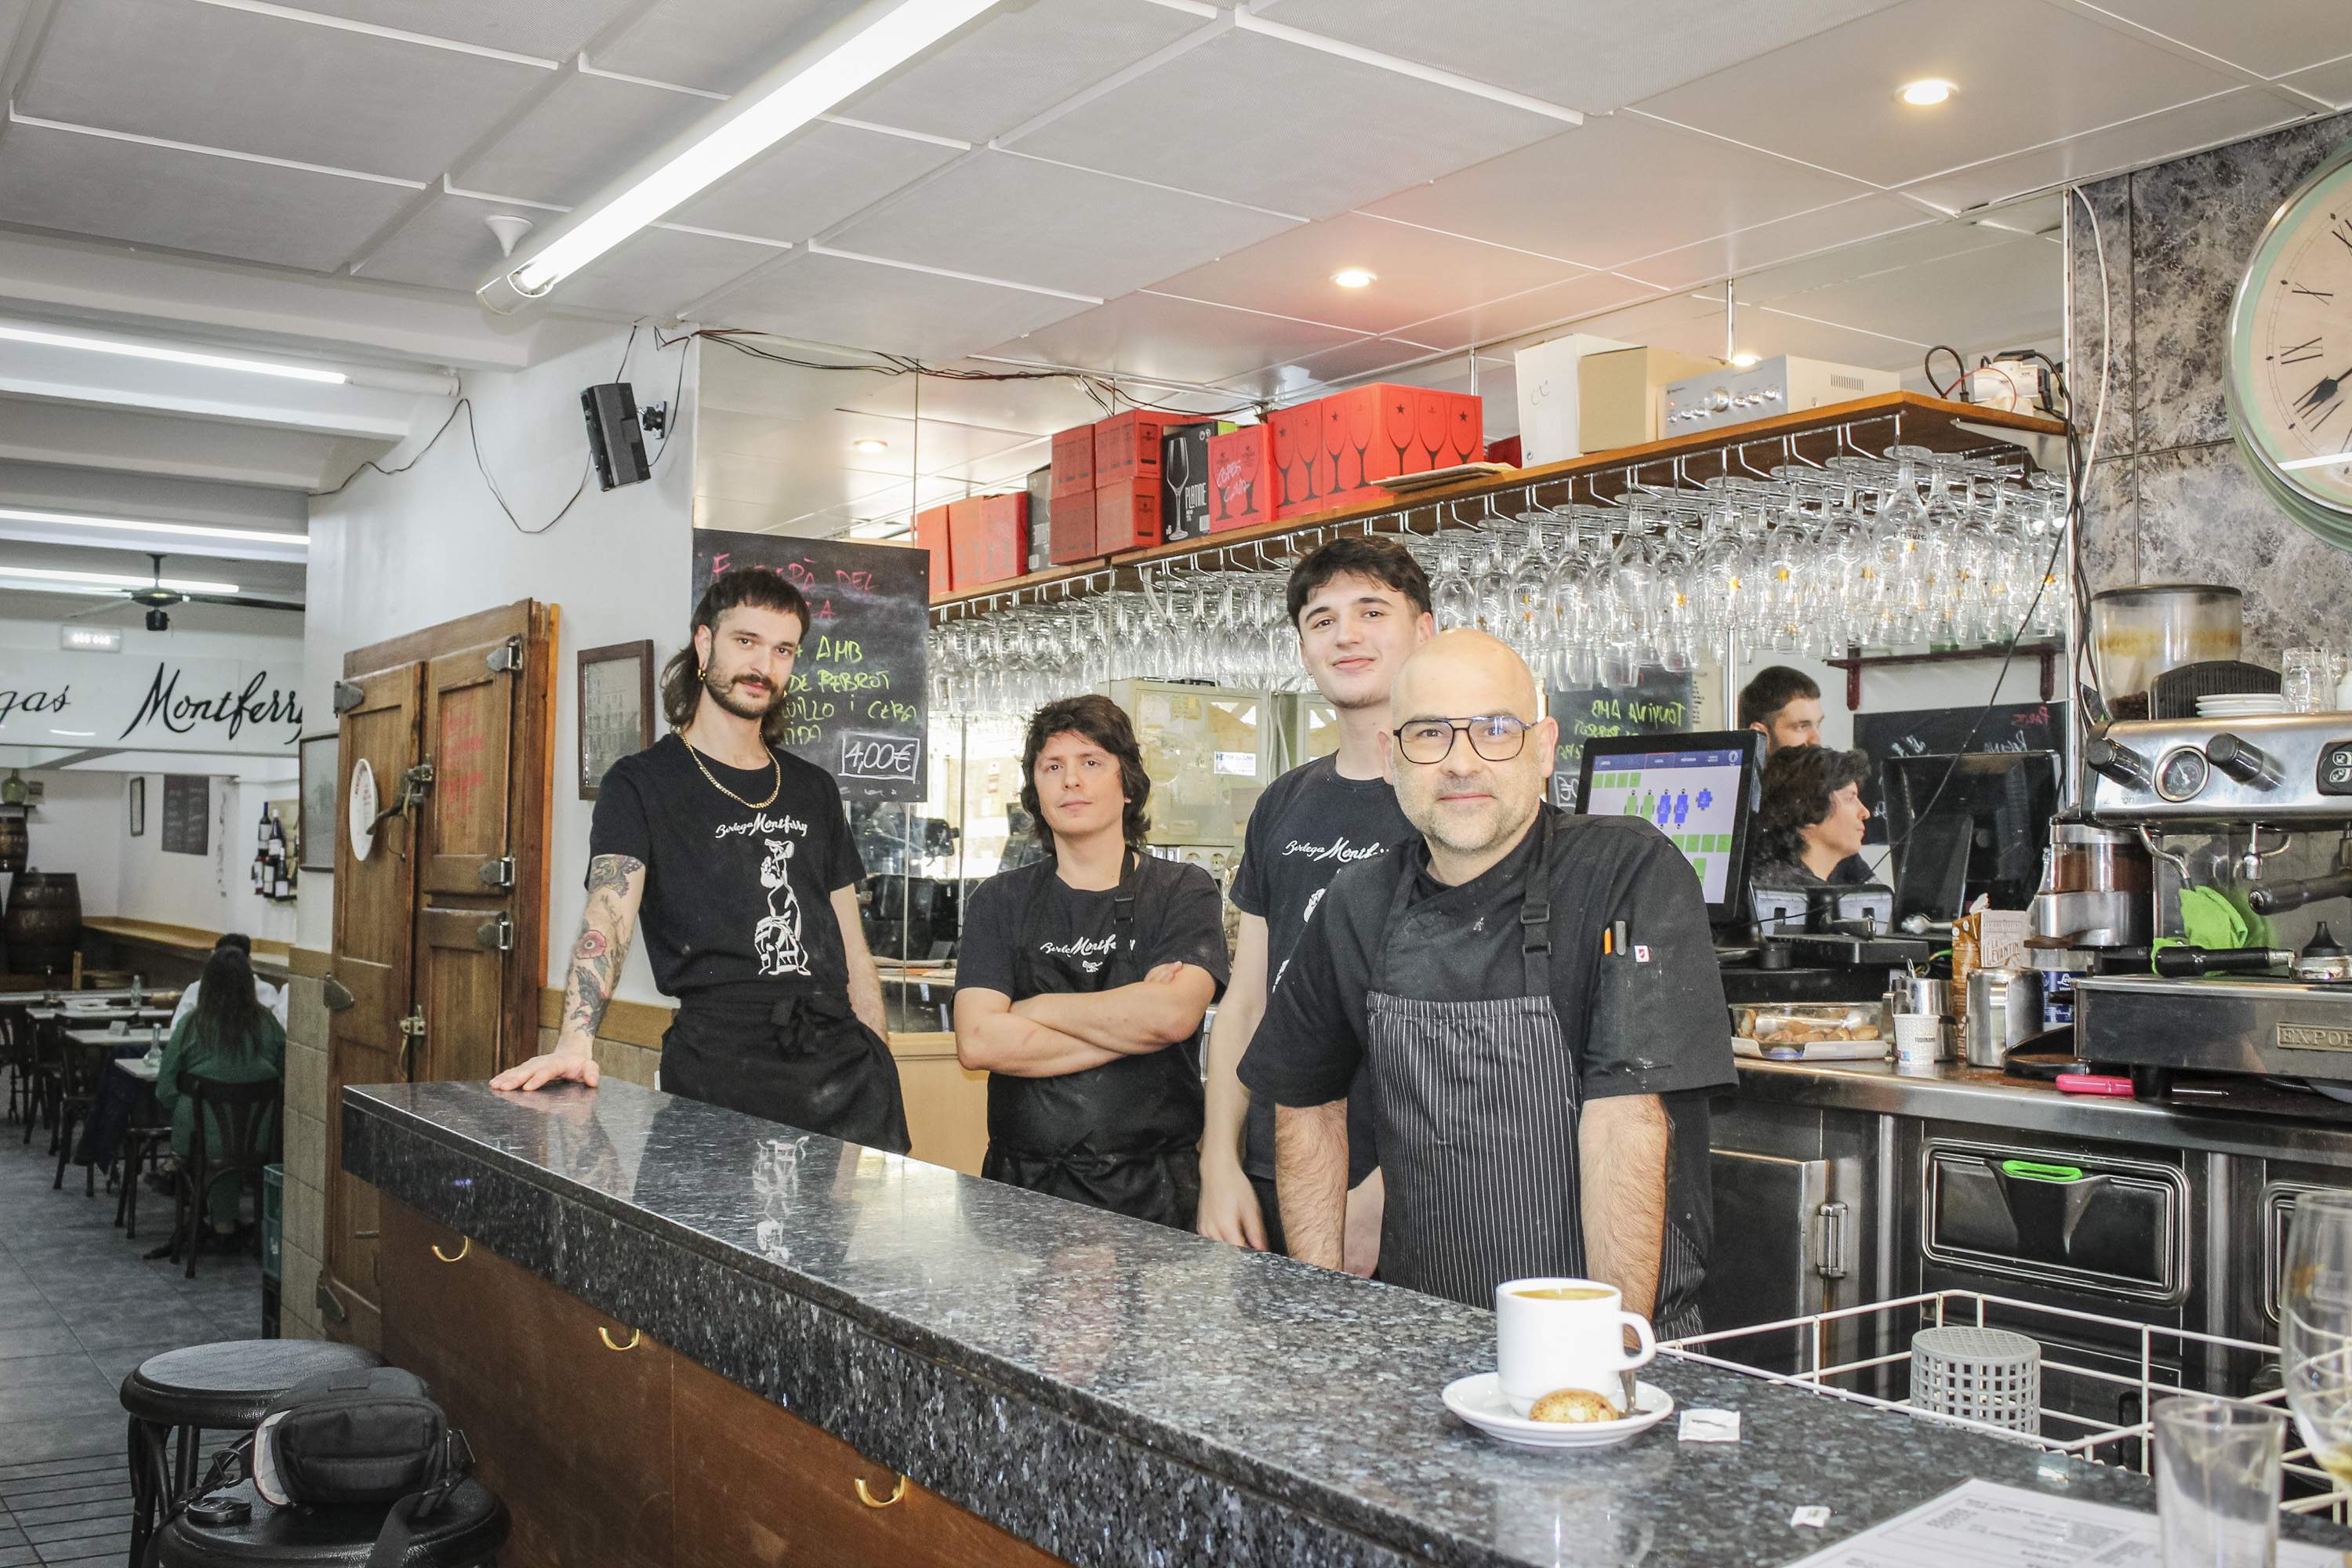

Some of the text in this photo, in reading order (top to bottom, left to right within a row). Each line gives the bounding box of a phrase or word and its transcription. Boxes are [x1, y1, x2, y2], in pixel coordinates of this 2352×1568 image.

[835, 568, 879, 590] DEL
[815, 634, 863, 663] AMB
[818, 669, 891, 694] PEBROT
[118, 662, 303, 745] Montferr
[844, 741, 914, 774] 4,00€
[1282, 840, 1326, 857] Bodega
[1987, 942, 2020, 967] LEVANTIN
